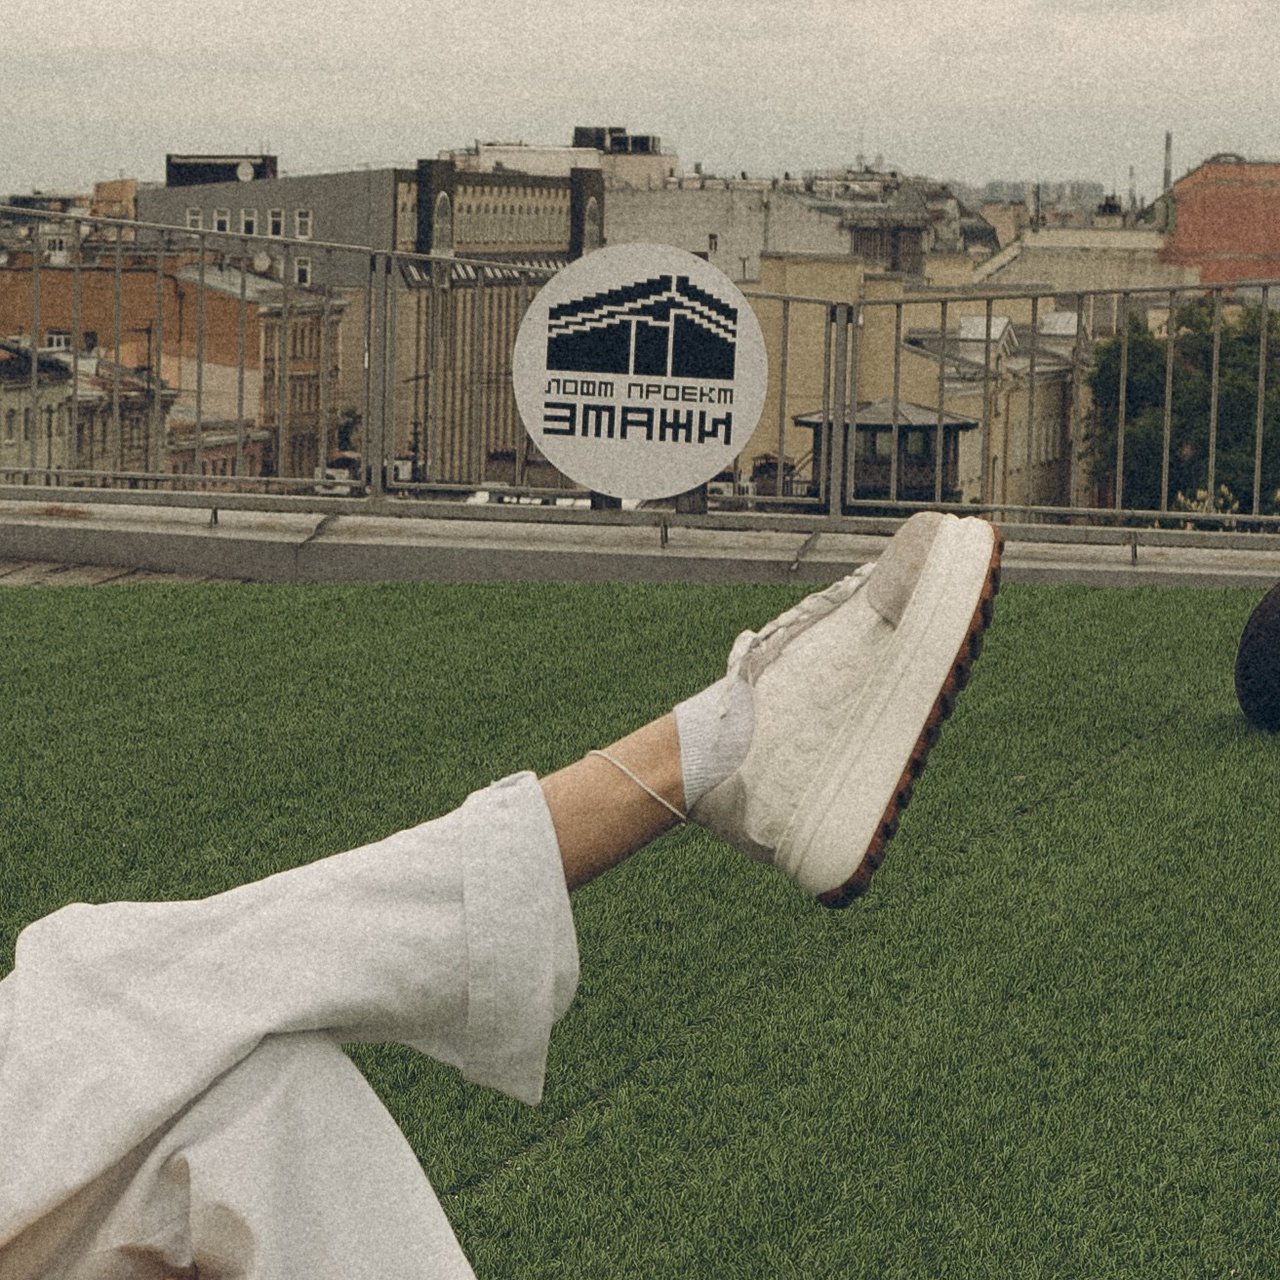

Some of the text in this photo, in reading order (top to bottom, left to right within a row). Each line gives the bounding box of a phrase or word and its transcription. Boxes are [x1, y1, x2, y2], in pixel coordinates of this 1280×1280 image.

[544, 378, 734, 405] ЛОФТ ПРОЕКТ
[542, 401, 732, 445] ЭТАЖИ
